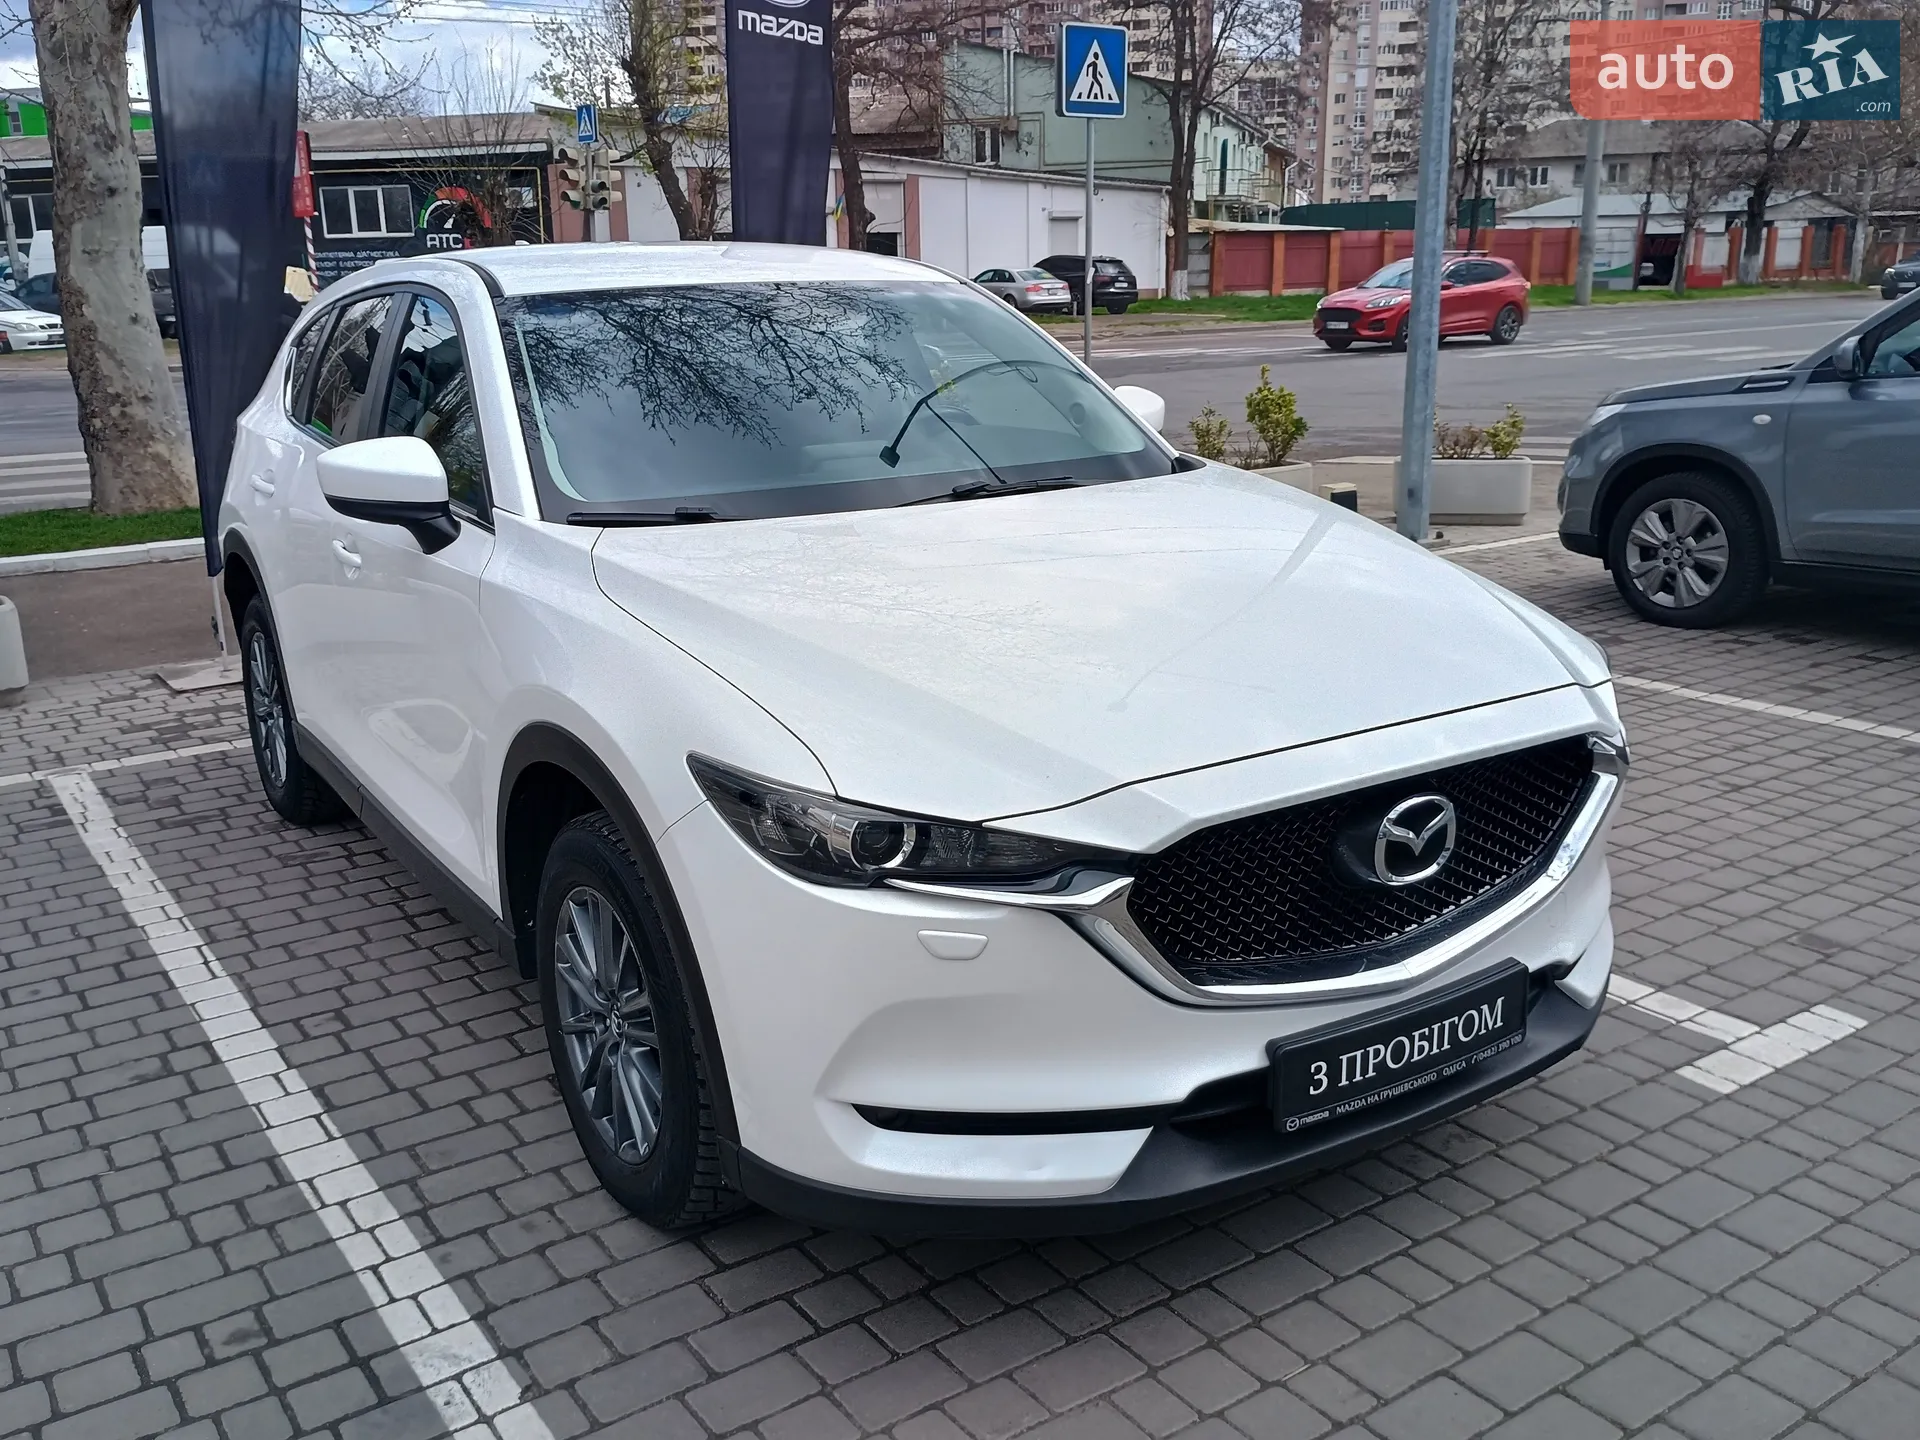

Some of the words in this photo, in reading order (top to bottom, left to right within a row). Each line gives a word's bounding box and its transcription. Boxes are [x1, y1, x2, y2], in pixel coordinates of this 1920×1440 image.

[737, 9, 824, 46] mazda
[1337, 996, 1505, 1087] ПРОБІГОМ
[1336, 1098, 1367, 1115] MAZDA
[1380, 1072, 1437, 1100] ГРУШЕВСЬКОГО
[1443, 1060, 1467, 1077] ОДЕСА
